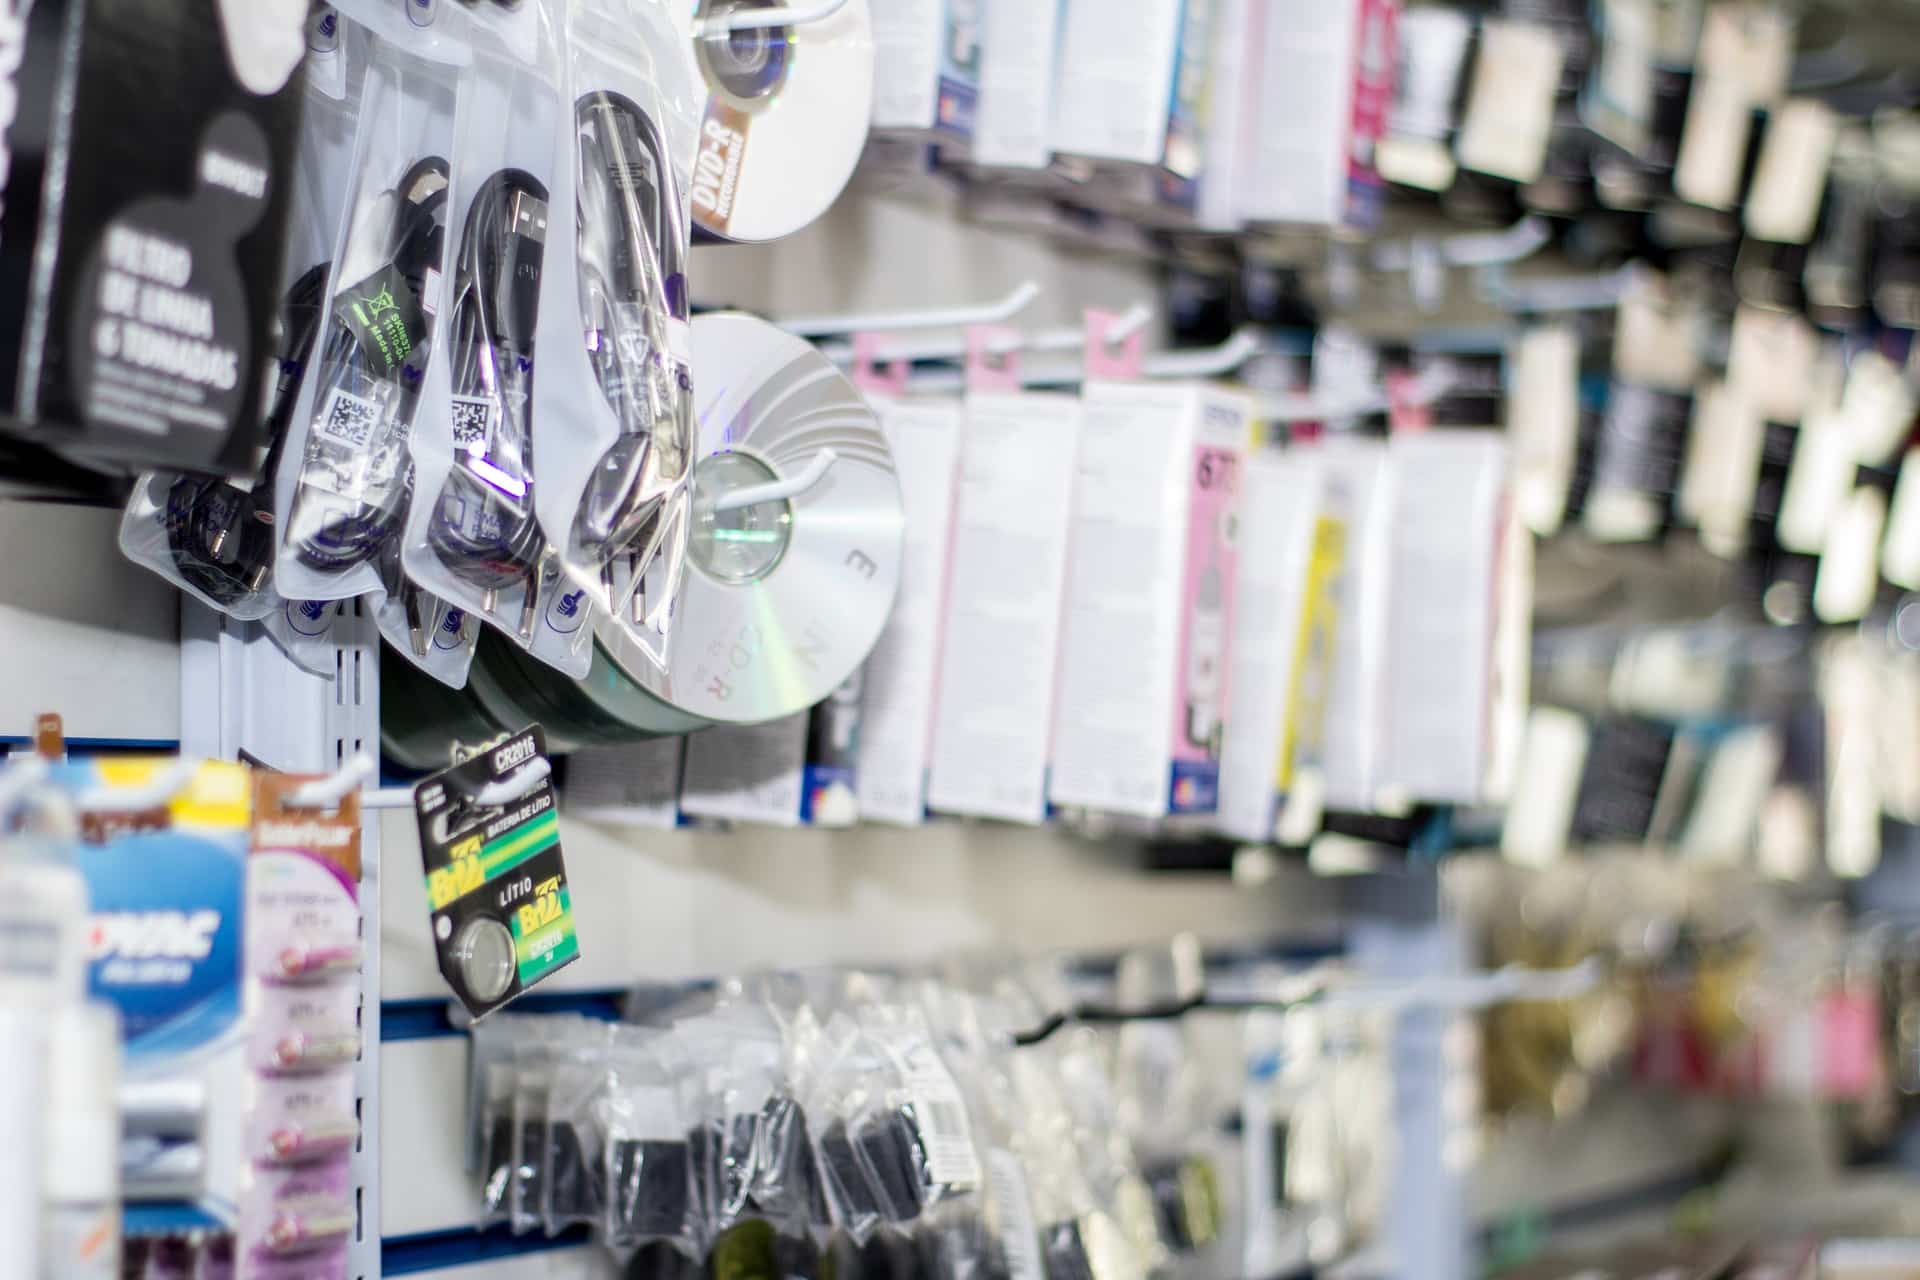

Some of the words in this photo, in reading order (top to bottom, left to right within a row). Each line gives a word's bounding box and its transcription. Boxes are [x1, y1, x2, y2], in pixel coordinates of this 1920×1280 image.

[692, 118, 732, 210] DVD-R
[494, 735, 537, 773] CR2016
[487, 810, 520, 838] BATERIA
[500, 876, 532, 907] LÍTIO
